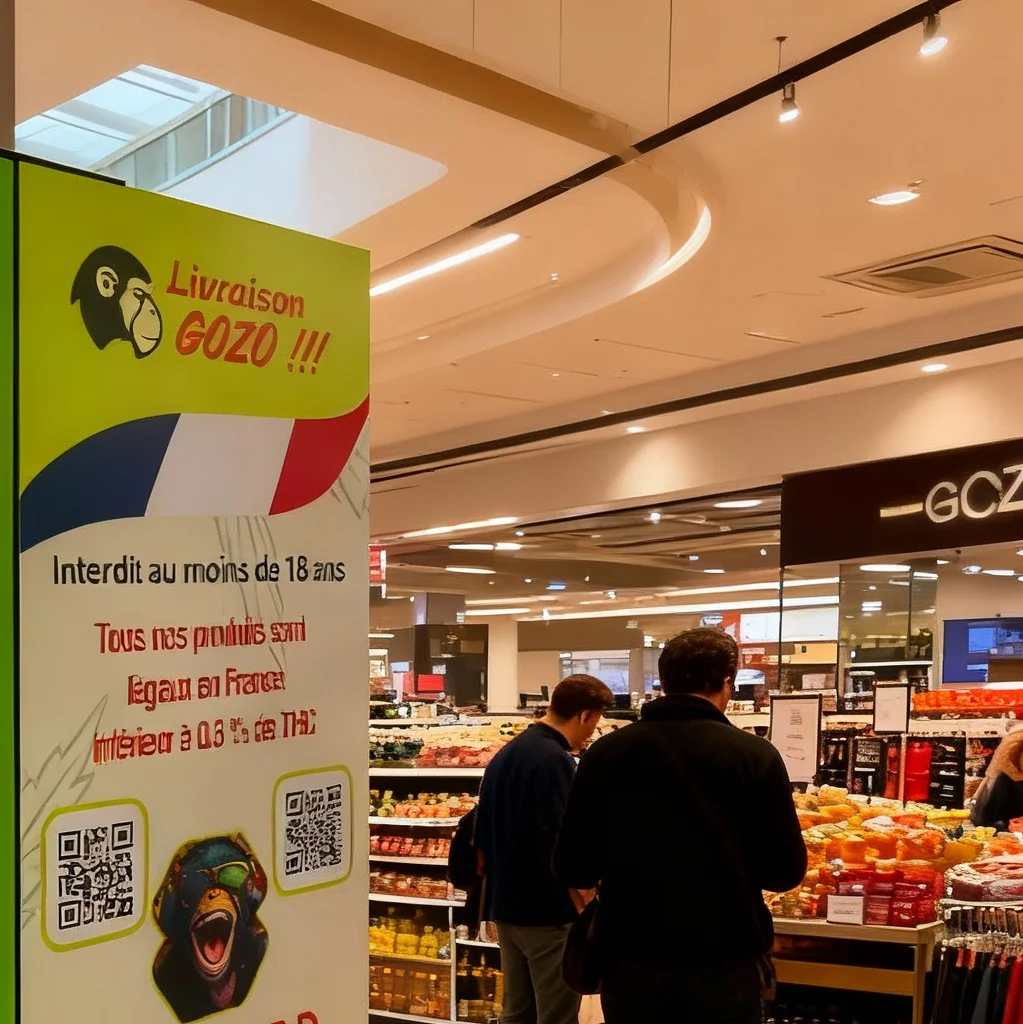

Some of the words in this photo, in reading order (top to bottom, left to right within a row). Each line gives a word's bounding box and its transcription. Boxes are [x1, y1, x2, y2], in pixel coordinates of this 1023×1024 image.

[166, 260, 304, 318] Livraison
[175, 310, 278, 368] GOZO
[287, 328, 330, 375] !!!
[53, 554, 142, 585] Interdit
[148, 563, 176, 584] au
[184, 554, 249, 584] moins
[254, 554, 280, 582] de
[285, 555, 309, 582] 18
[93, 622, 146, 653] Tous
